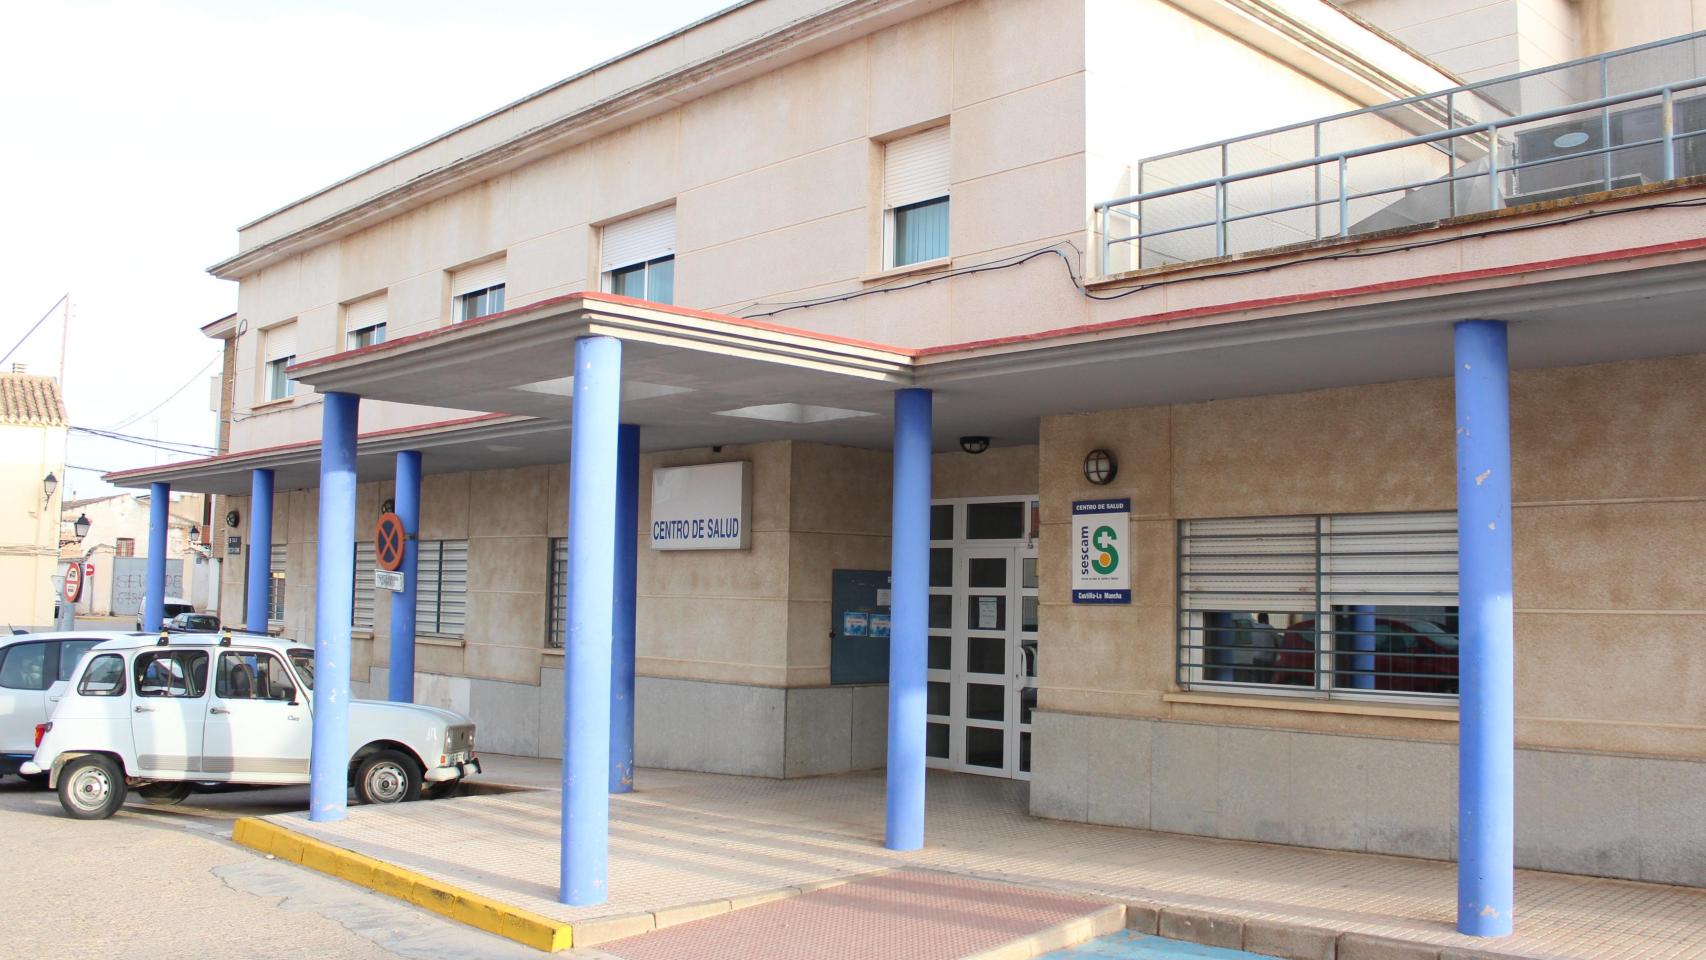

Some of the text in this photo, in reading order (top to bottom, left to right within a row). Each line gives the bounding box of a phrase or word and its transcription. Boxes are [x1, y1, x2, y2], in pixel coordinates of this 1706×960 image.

[653, 517, 739, 540] CENTRO DE SALUD
[1081, 526, 1089, 575] sescam
